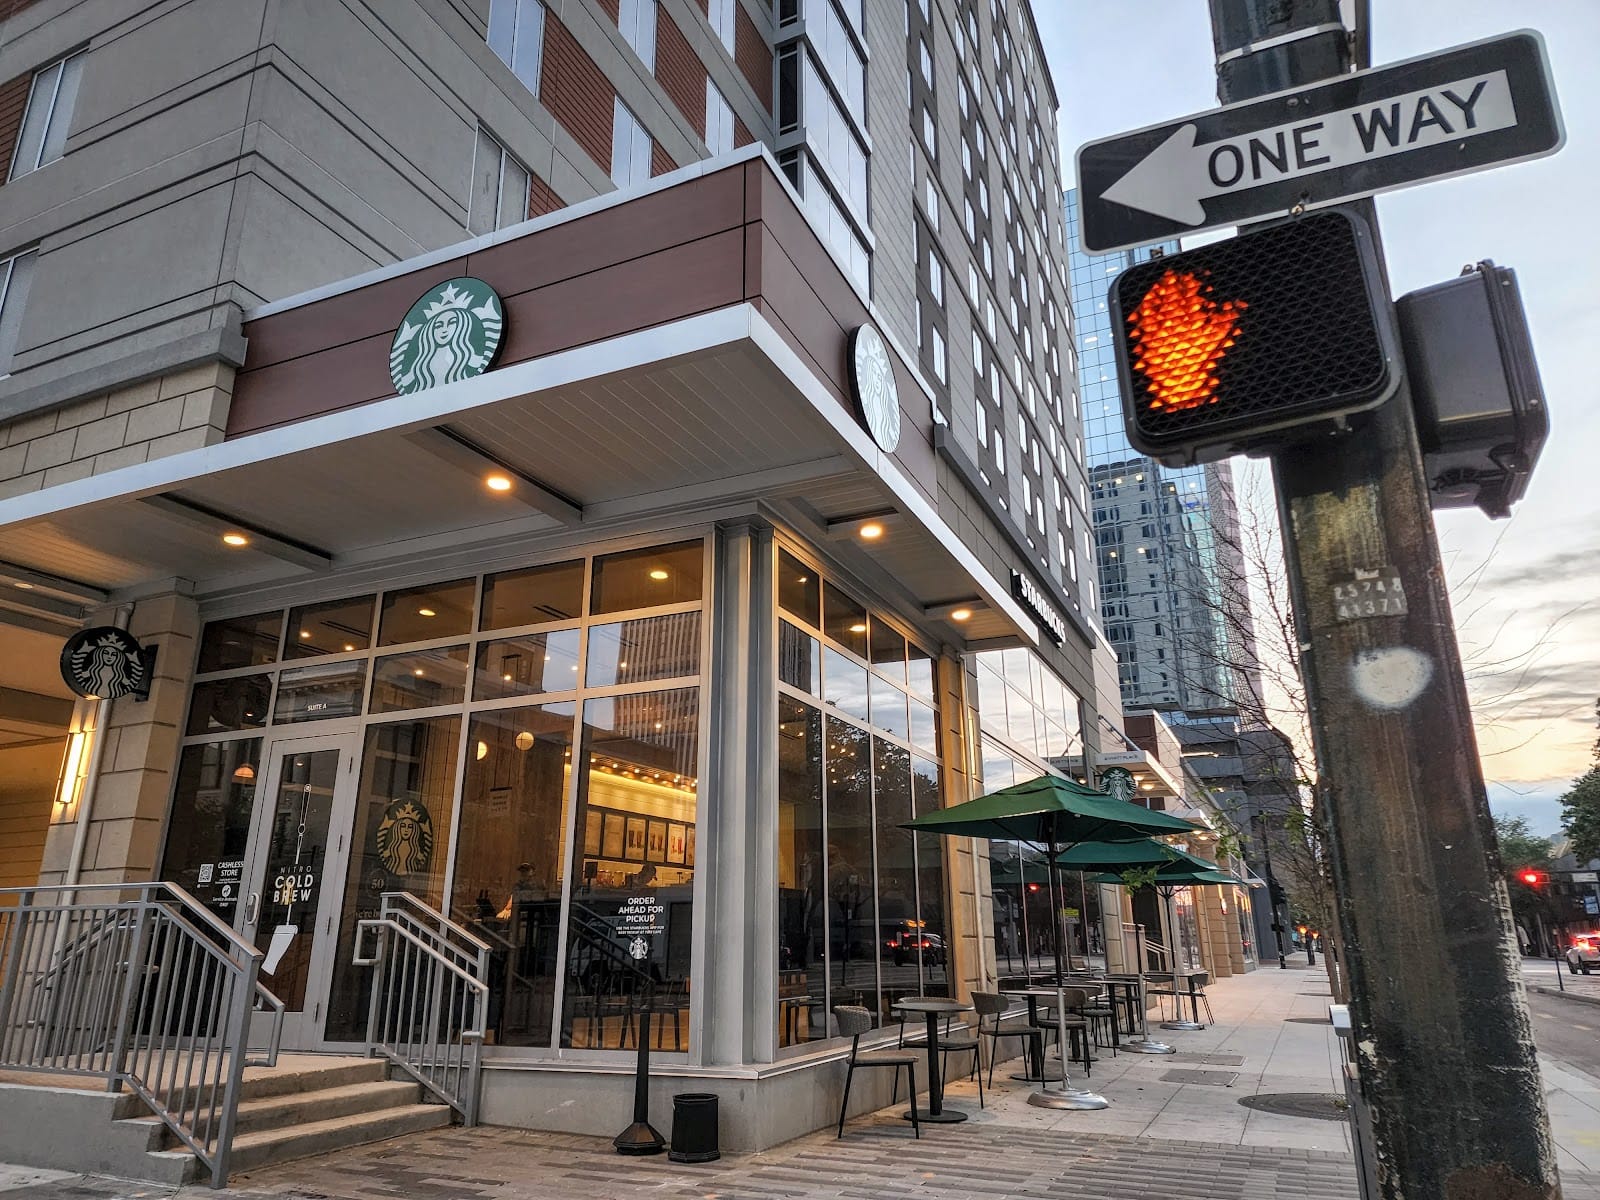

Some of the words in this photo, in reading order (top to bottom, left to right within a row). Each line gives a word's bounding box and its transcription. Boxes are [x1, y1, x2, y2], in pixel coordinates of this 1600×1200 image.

[1208, 122, 1330, 187] ONE
[1352, 80, 1488, 153] WAY
[1020, 573, 1066, 643] STARBUCKS
[307, 703, 322, 711] SUITE
[218, 861, 244, 869] CASHLESS
[280, 865, 312, 874] NITRO
[220, 869, 239, 877] STORE
[275, 874, 314, 889] COLD
[273, 889, 312, 903] BREW
[627, 897, 656, 905] ORDER
[618, 906, 646, 914] AHEAD
[647, 905, 664, 914] FOR
[626, 914, 655, 923] PICKUP
